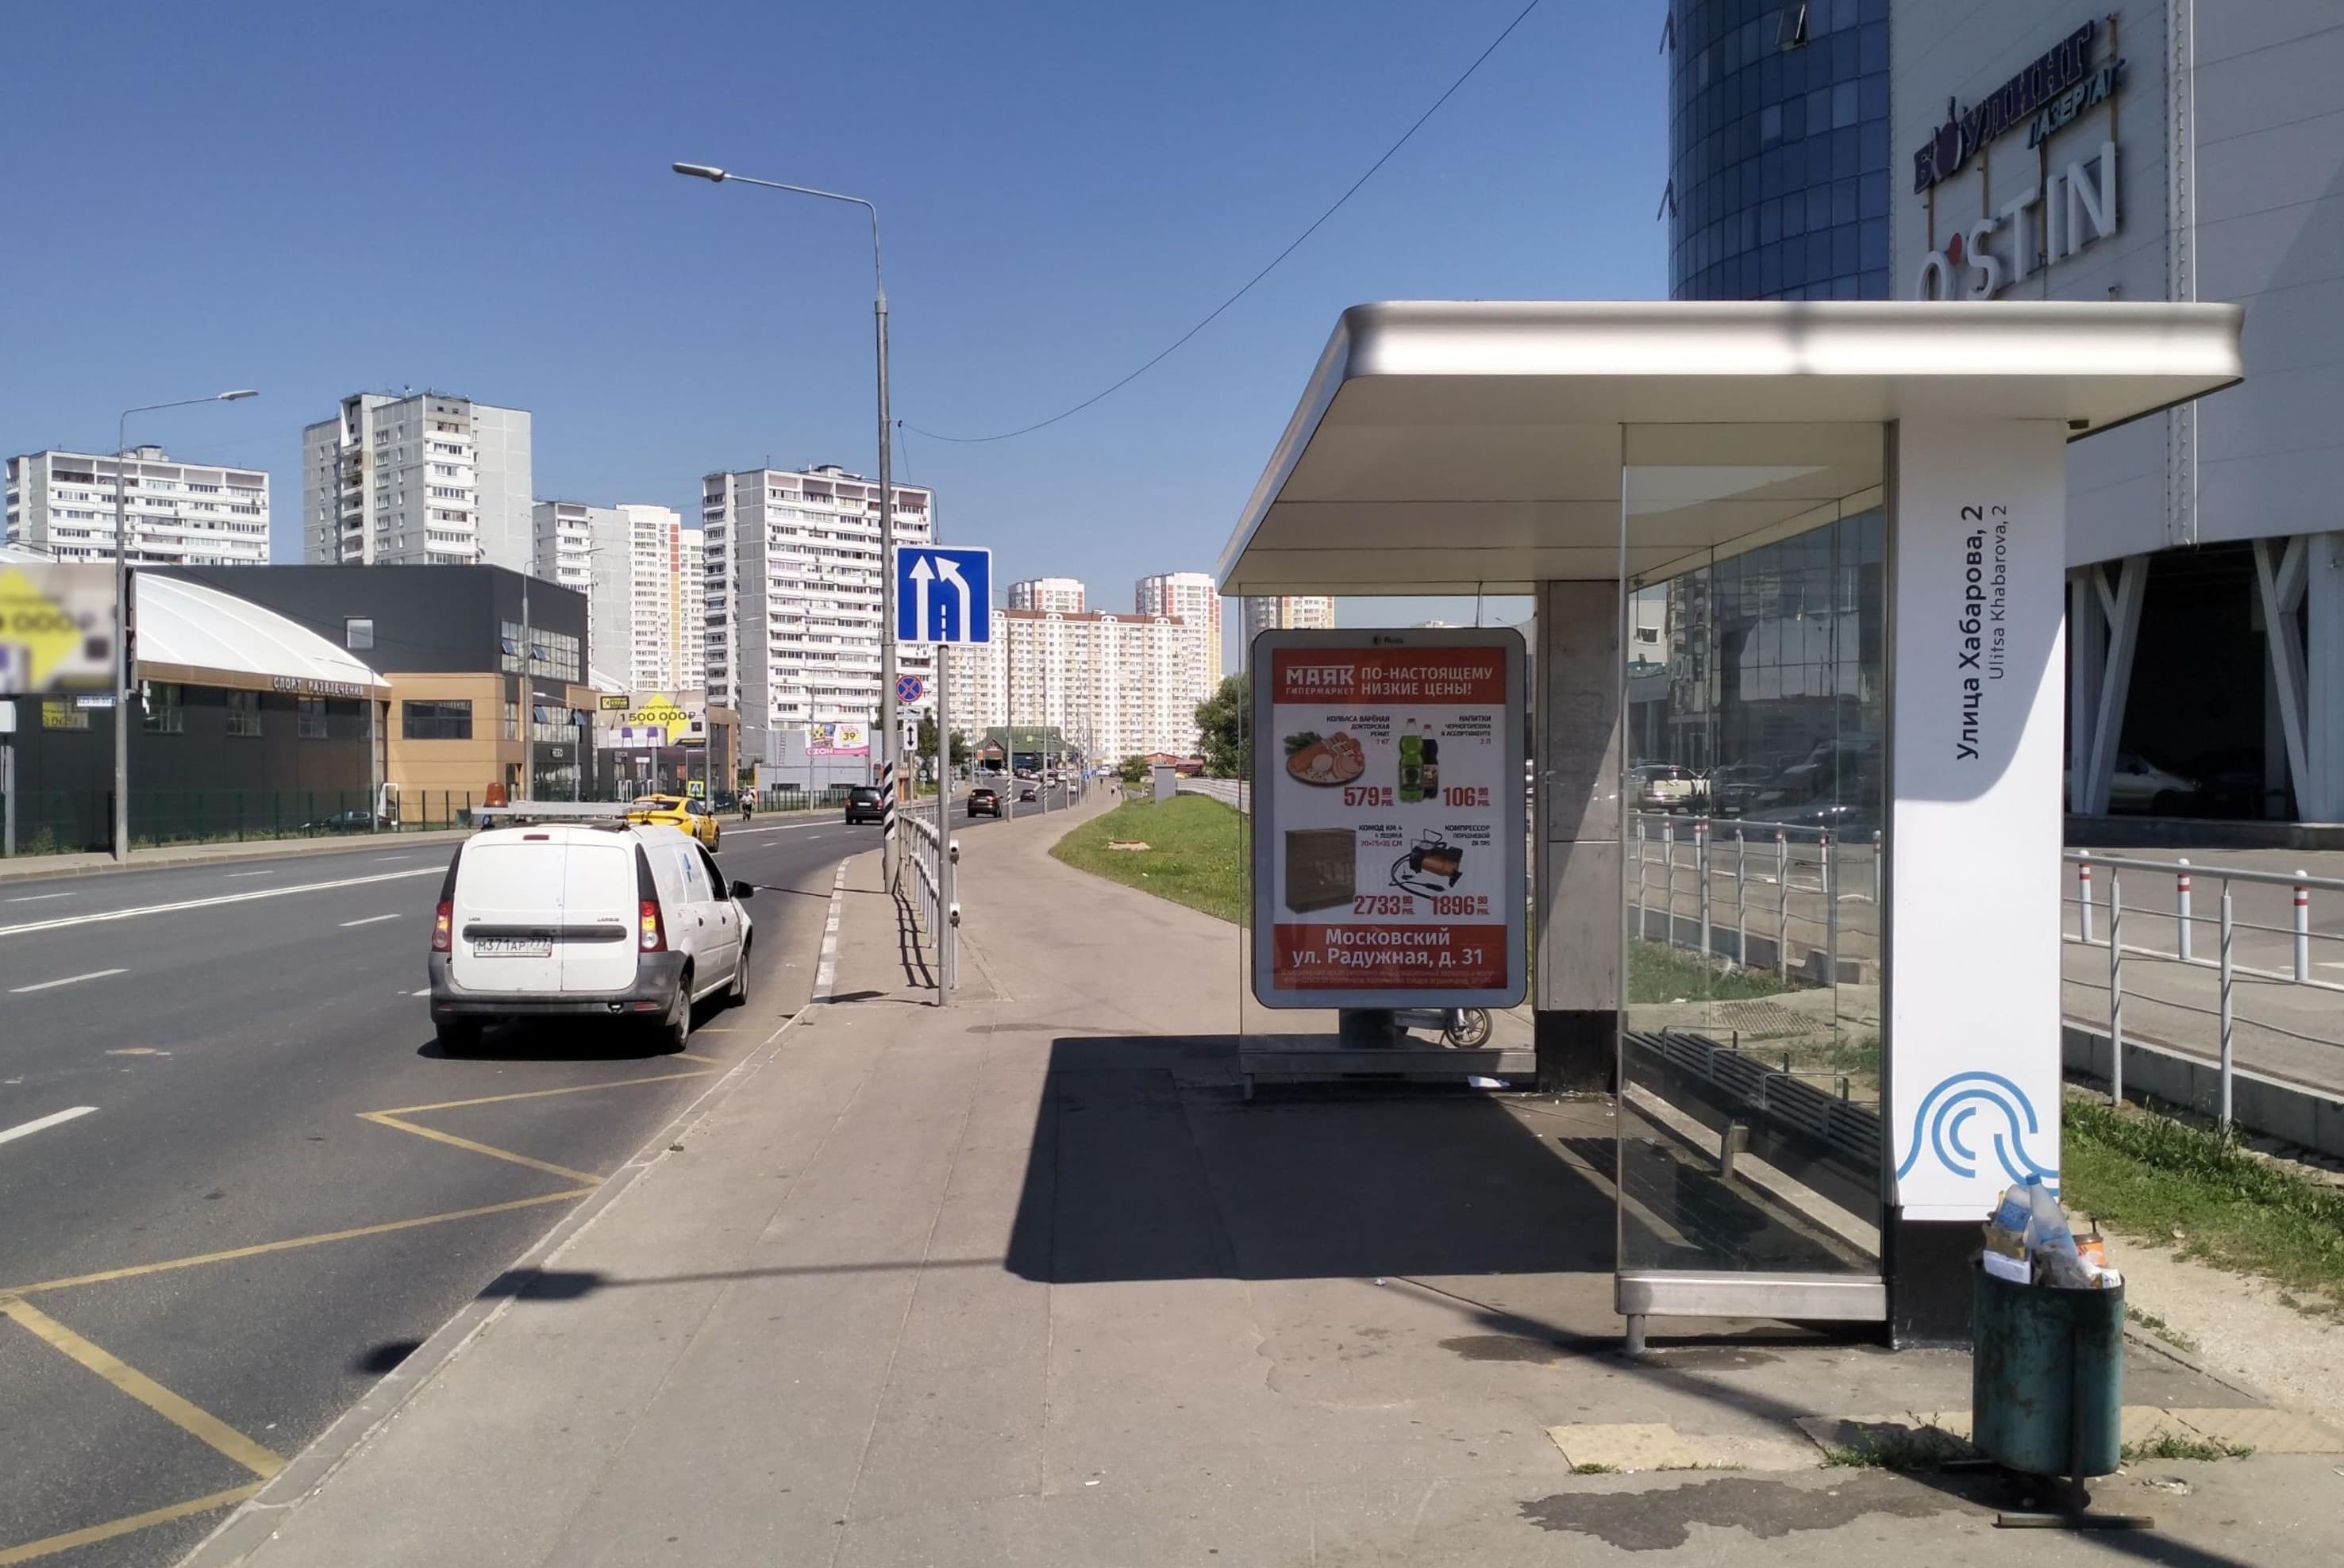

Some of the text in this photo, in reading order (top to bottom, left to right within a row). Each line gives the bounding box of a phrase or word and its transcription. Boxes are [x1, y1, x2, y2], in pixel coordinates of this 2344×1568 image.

[1914, 20, 2094, 194] БОУЛИНГ
[2027, 59, 2126, 149] ЛАЗЕРТАГ
[1989, 505, 2008, 679] Ulitsa Khabarova, 2
[1957, 505, 1987, 760] Улица Хабарова, 2
[1286, 665, 1355, 686] МАЯК
[1361, 667, 1493, 682] ПО-НАСТОЯЩЕМУ
[273, 677, 364, 696] СПОРТ РАЗВЛЕЧЕНИЯ
[1286, 686, 1355, 695] ГИПЕРМАРКЕТ
[1361, 682, 1472, 697] НИЗКИЕ ЦЕНЫ!
[629, 713, 656, 722] 500
[1344, 787, 1379, 806] 579
[1442, 787, 1475, 806] 106
[1353, 895, 1401, 915] 2733
[1431, 895, 1475, 915] 1896
[1326, 928, 1450, 946] Московский
[1293, 948, 1484, 968] ул. Радужная, д. 31
